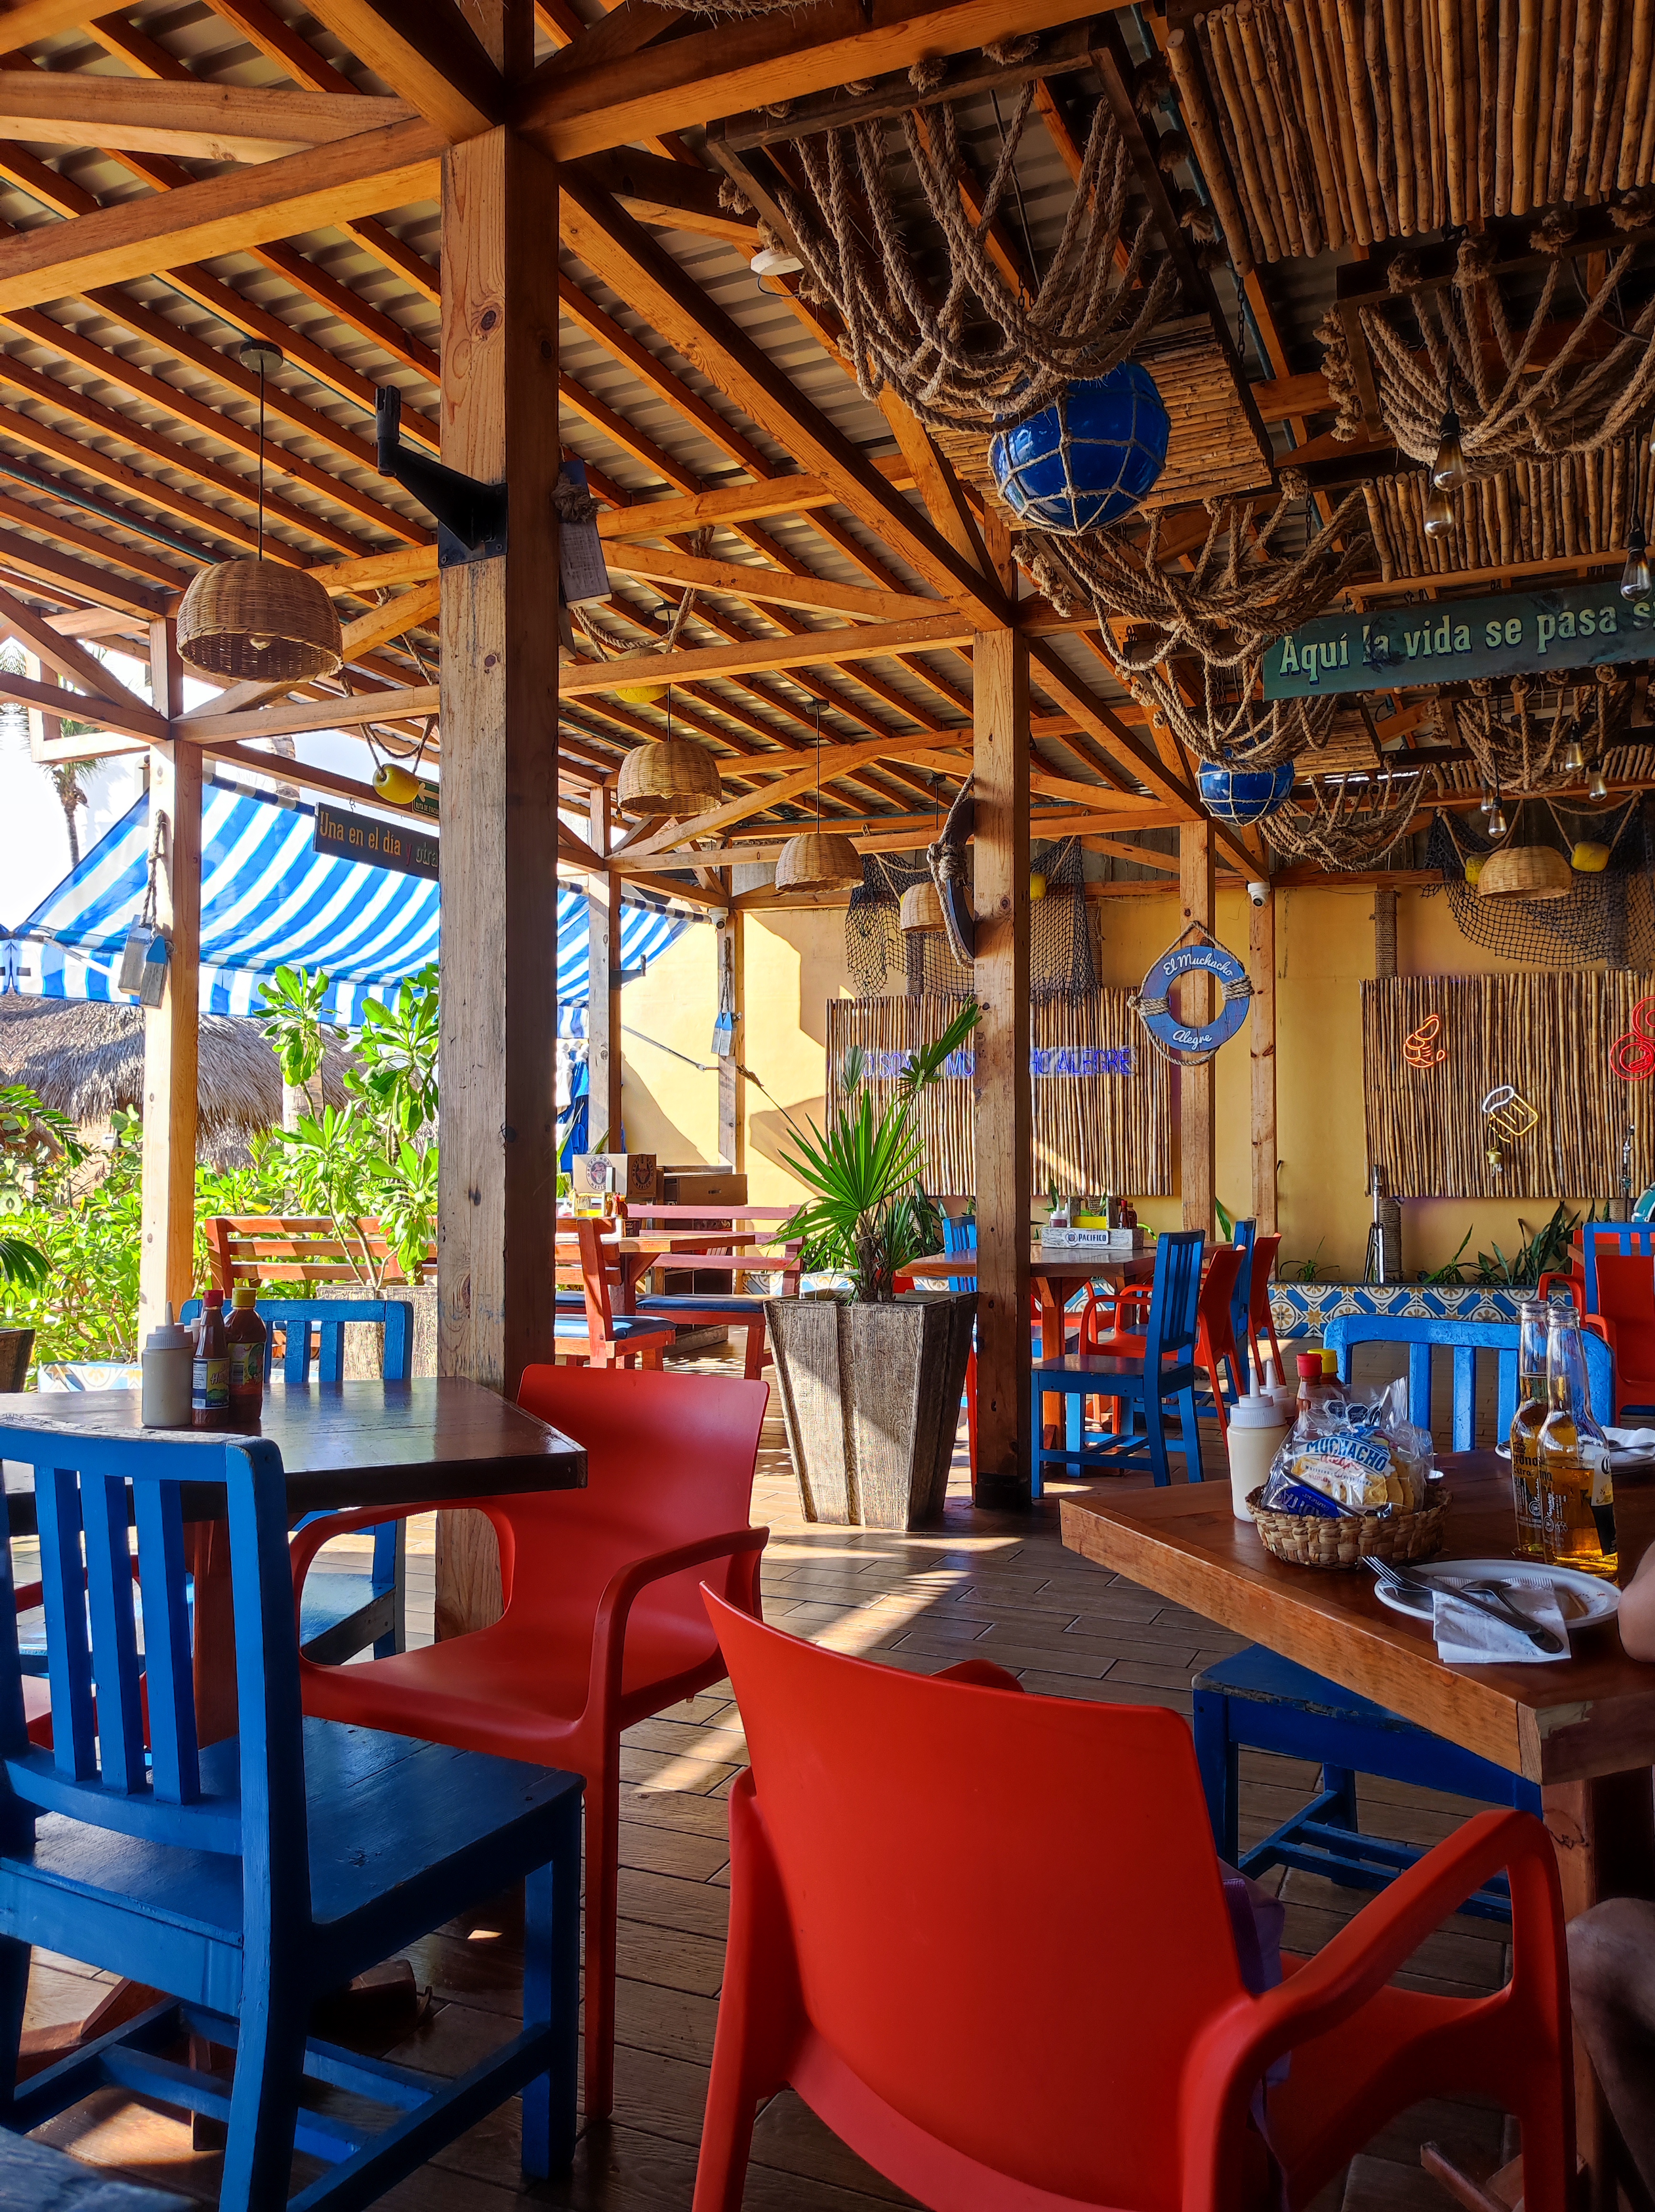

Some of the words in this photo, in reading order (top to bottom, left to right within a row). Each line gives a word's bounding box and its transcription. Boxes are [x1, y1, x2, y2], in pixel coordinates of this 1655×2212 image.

[1279, 632, 1349, 685] Aquí
[1362, 624, 1390, 666] la
[1403, 614, 1472, 660] vida
[1485, 617, 1523, 650] se
[1537, 606, 1618, 656] pasa
[1633, 602, 1655, 630] s
[416, 802, 424, 810] RUTA
[319, 811, 345, 842] Una
[348, 827, 364, 847] en
[368, 826, 379, 851] el
[383, 830, 401, 856] día
[406, 843, 413, 866] y
[1163, 957, 1178, 976] El
[1177, 952, 1233, 977] Muchacho
[1172, 1029, 1213, 1051] Alegre
[1057, 1048, 1130, 1075] ALEGRE
[1078, 1233, 1106, 1242] PACIFICO
[1306, 1437, 1388, 1472] MUCHACHO
